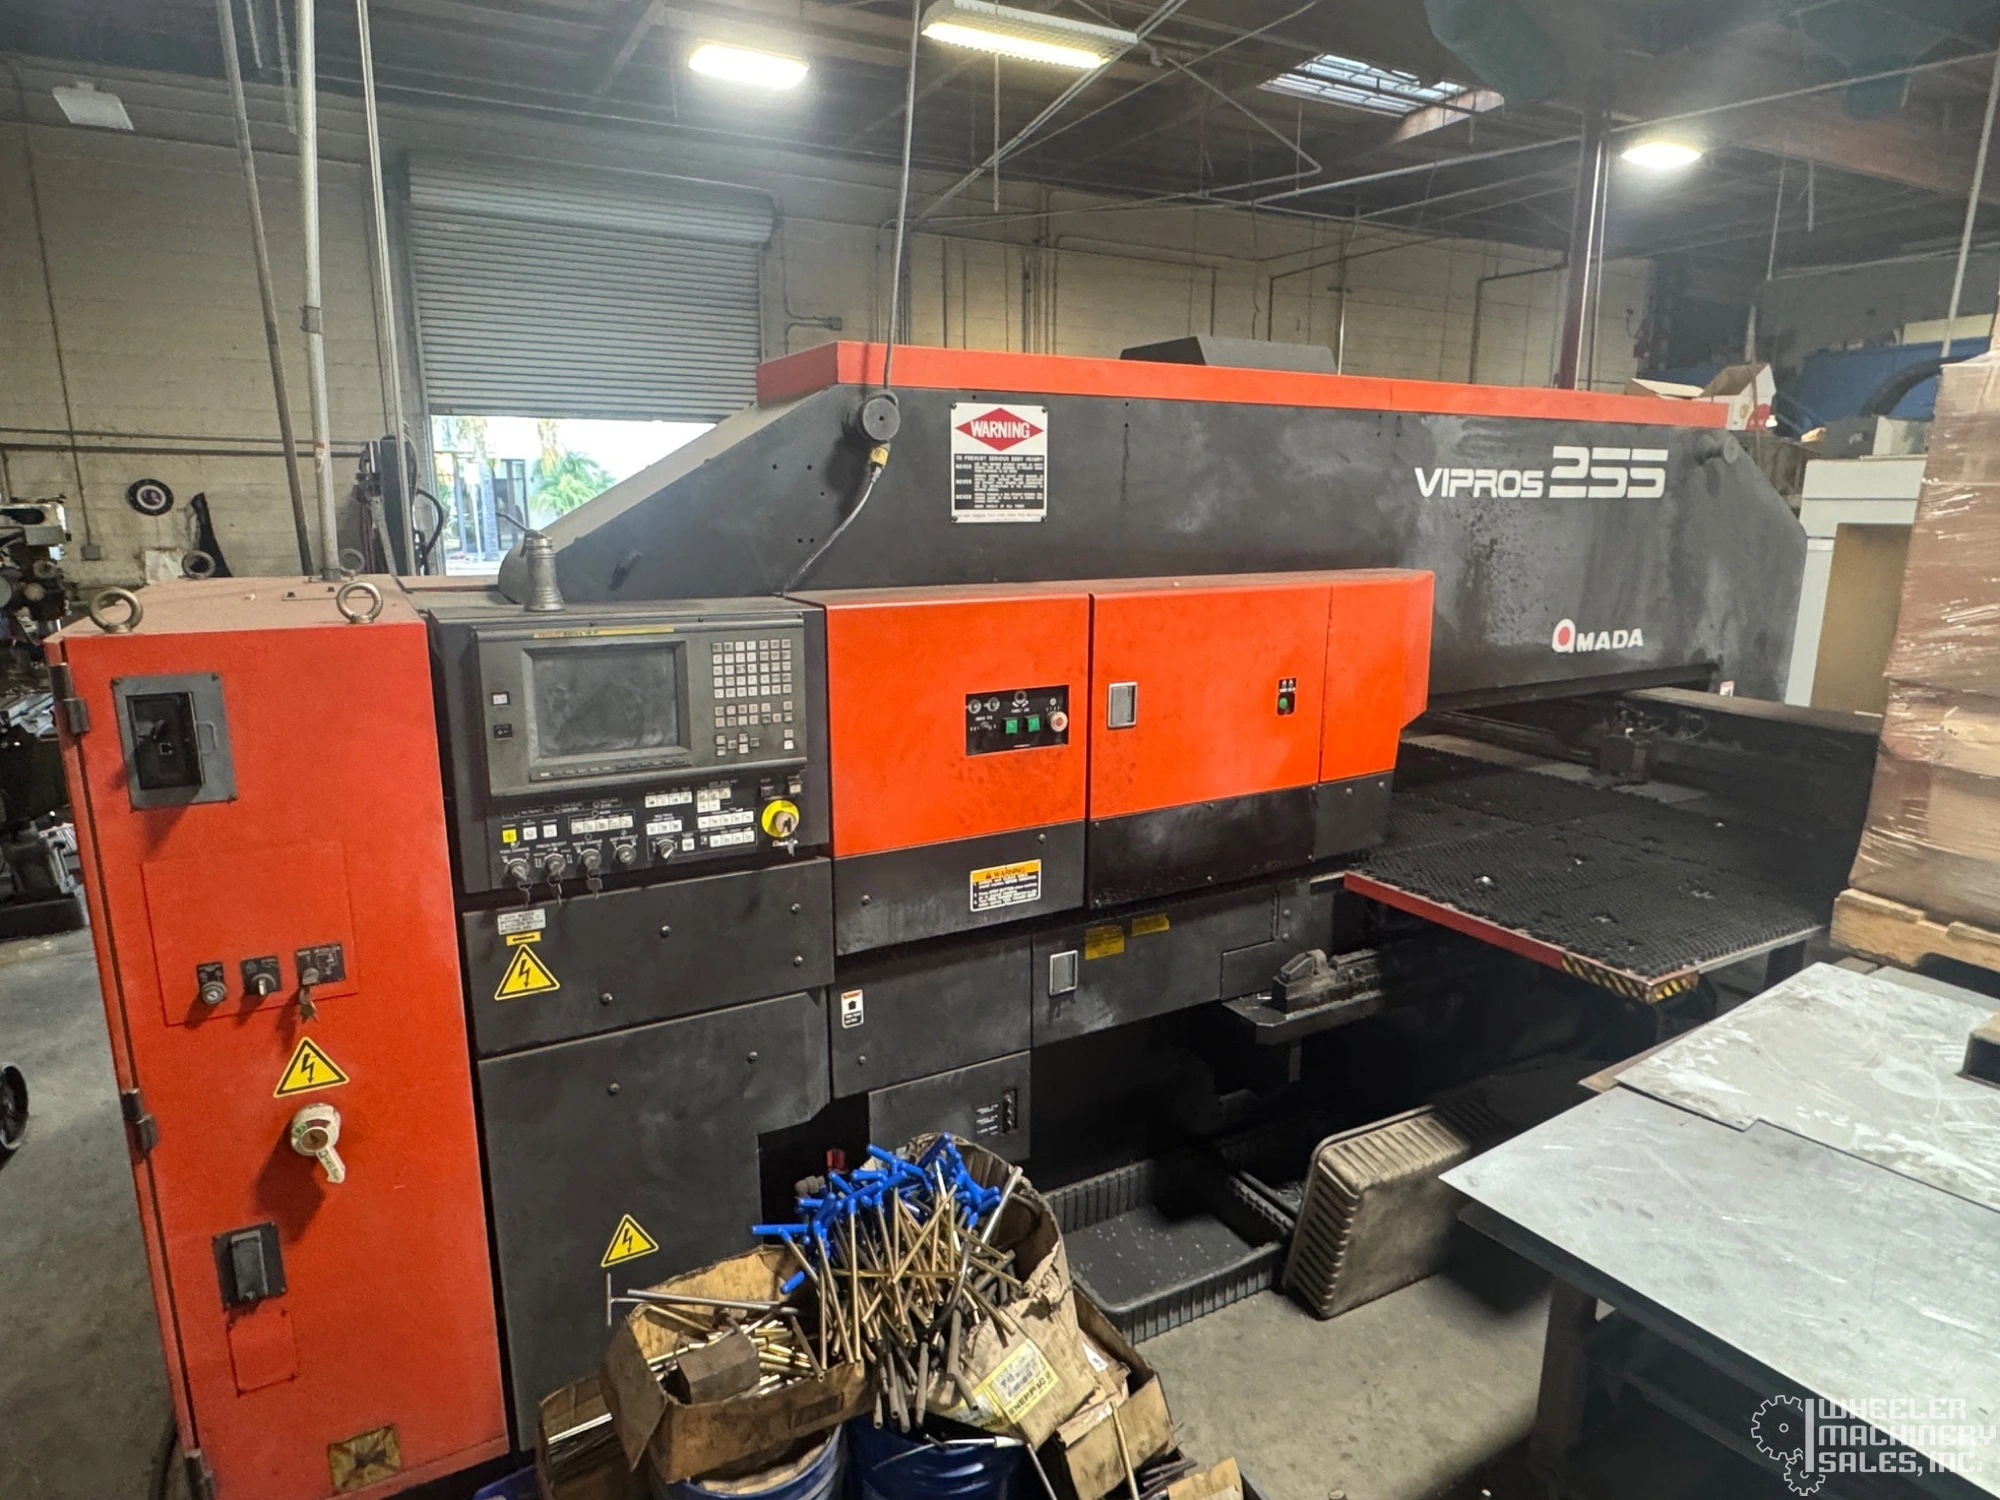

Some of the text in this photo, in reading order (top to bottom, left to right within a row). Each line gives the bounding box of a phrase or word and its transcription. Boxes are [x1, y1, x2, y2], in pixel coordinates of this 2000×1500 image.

[970, 420, 1031, 439] WARNING
[1414, 445, 1669, 498] VIPROS 255
[1551, 618, 1644, 653] AMADA
